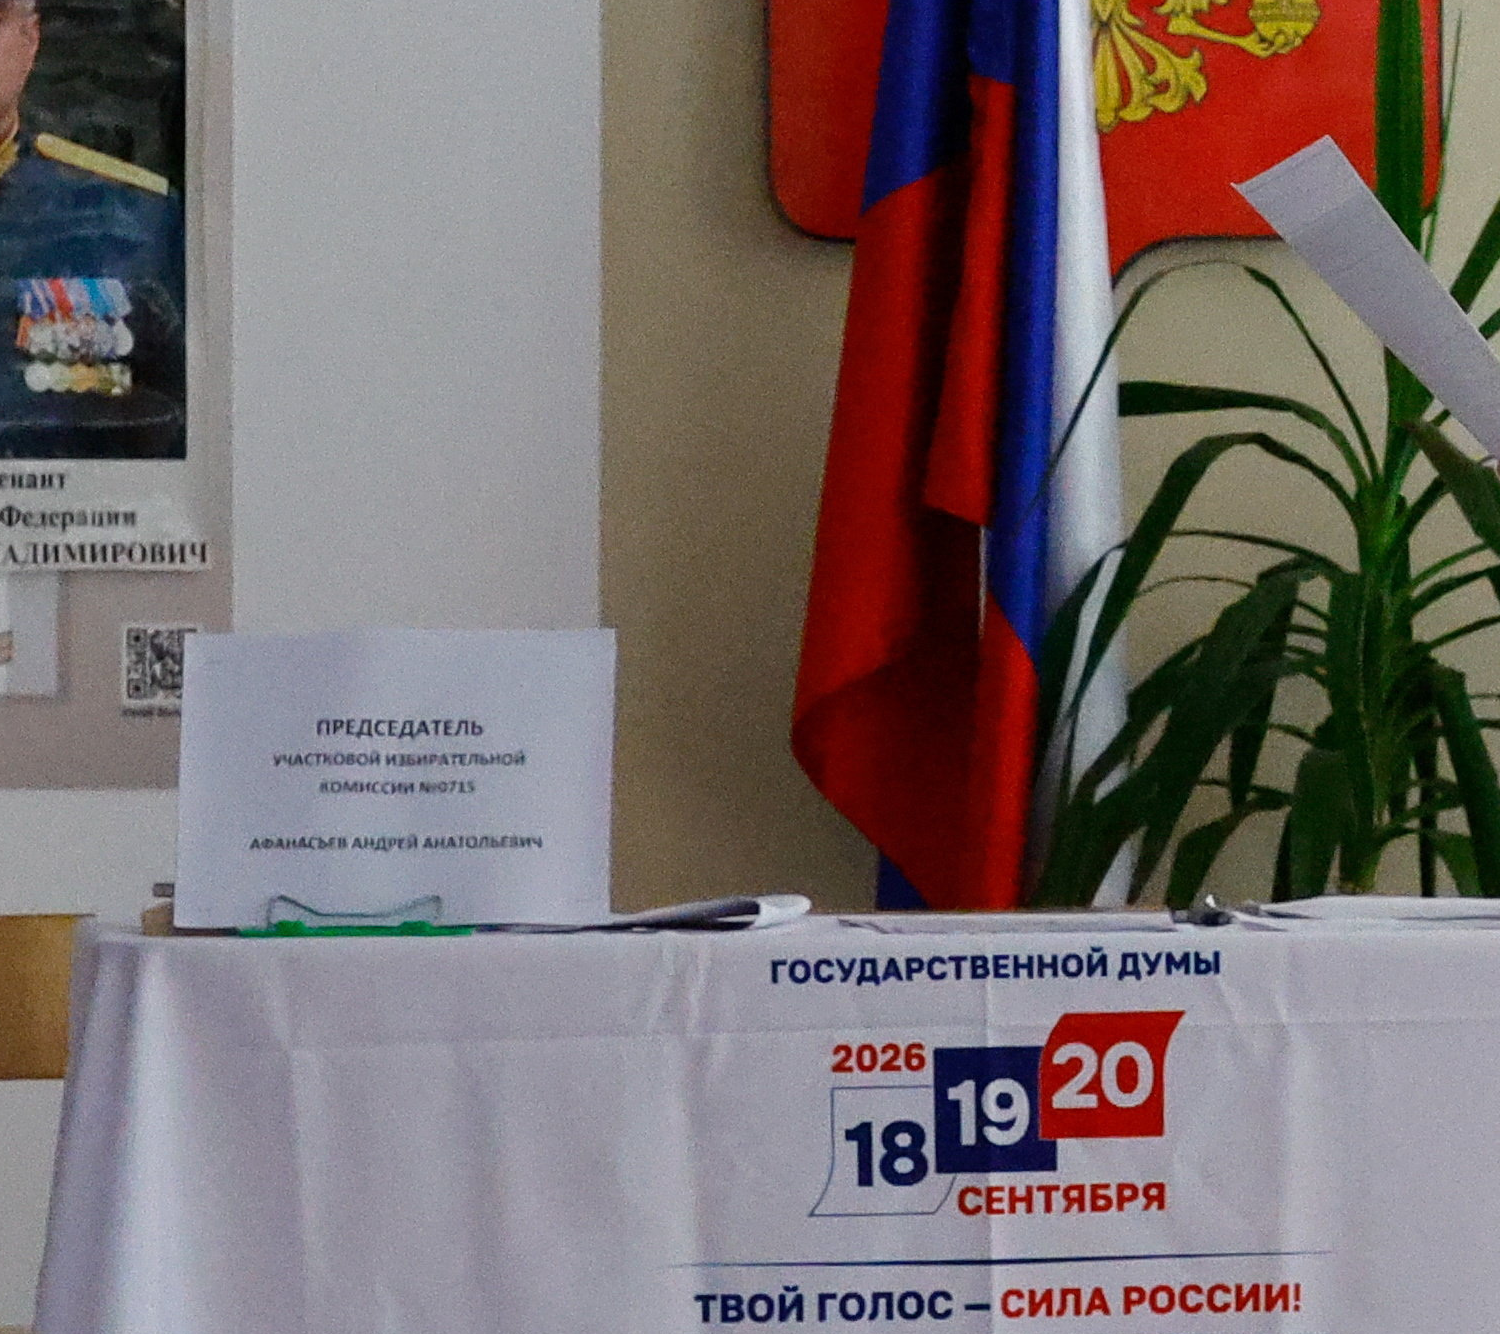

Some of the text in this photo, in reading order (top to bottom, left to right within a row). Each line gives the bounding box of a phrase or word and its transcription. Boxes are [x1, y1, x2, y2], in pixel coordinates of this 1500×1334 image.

[316, 718, 485, 740] ПРЕДСЕДАТЕЛЬ
[272, 750, 527, 768] УЧАСТКОВОЙ ИЗБИРАТЕЛЬНОЙ
[319, 779, 416, 795] КОМИССИИ
[249, 832, 544, 852] АФАНАСЬЕВ АНДРЕЙ АНАТОЛЬЕВИЧ
[770, 946, 1222, 986] ГОСУДАРСТВЕННОЙ ДУМЫ
[831, 1042, 927, 1074] 2026
[1051, 1040, 1156, 1109] 20
[948, 1078, 1030, 1146] 19
[843, 1119, 930, 1188] 18
[957, 1181, 1168, 1217] СЕНТЯБРЯ
[695, 1284, 805, 1324] ТВОЙ
[816, 1289, 953, 1323] ГОЛОС
[1000, 1286, 1112, 1319] СИЛА
[1122, 1281, 1304, 1317] РОССИИ!
